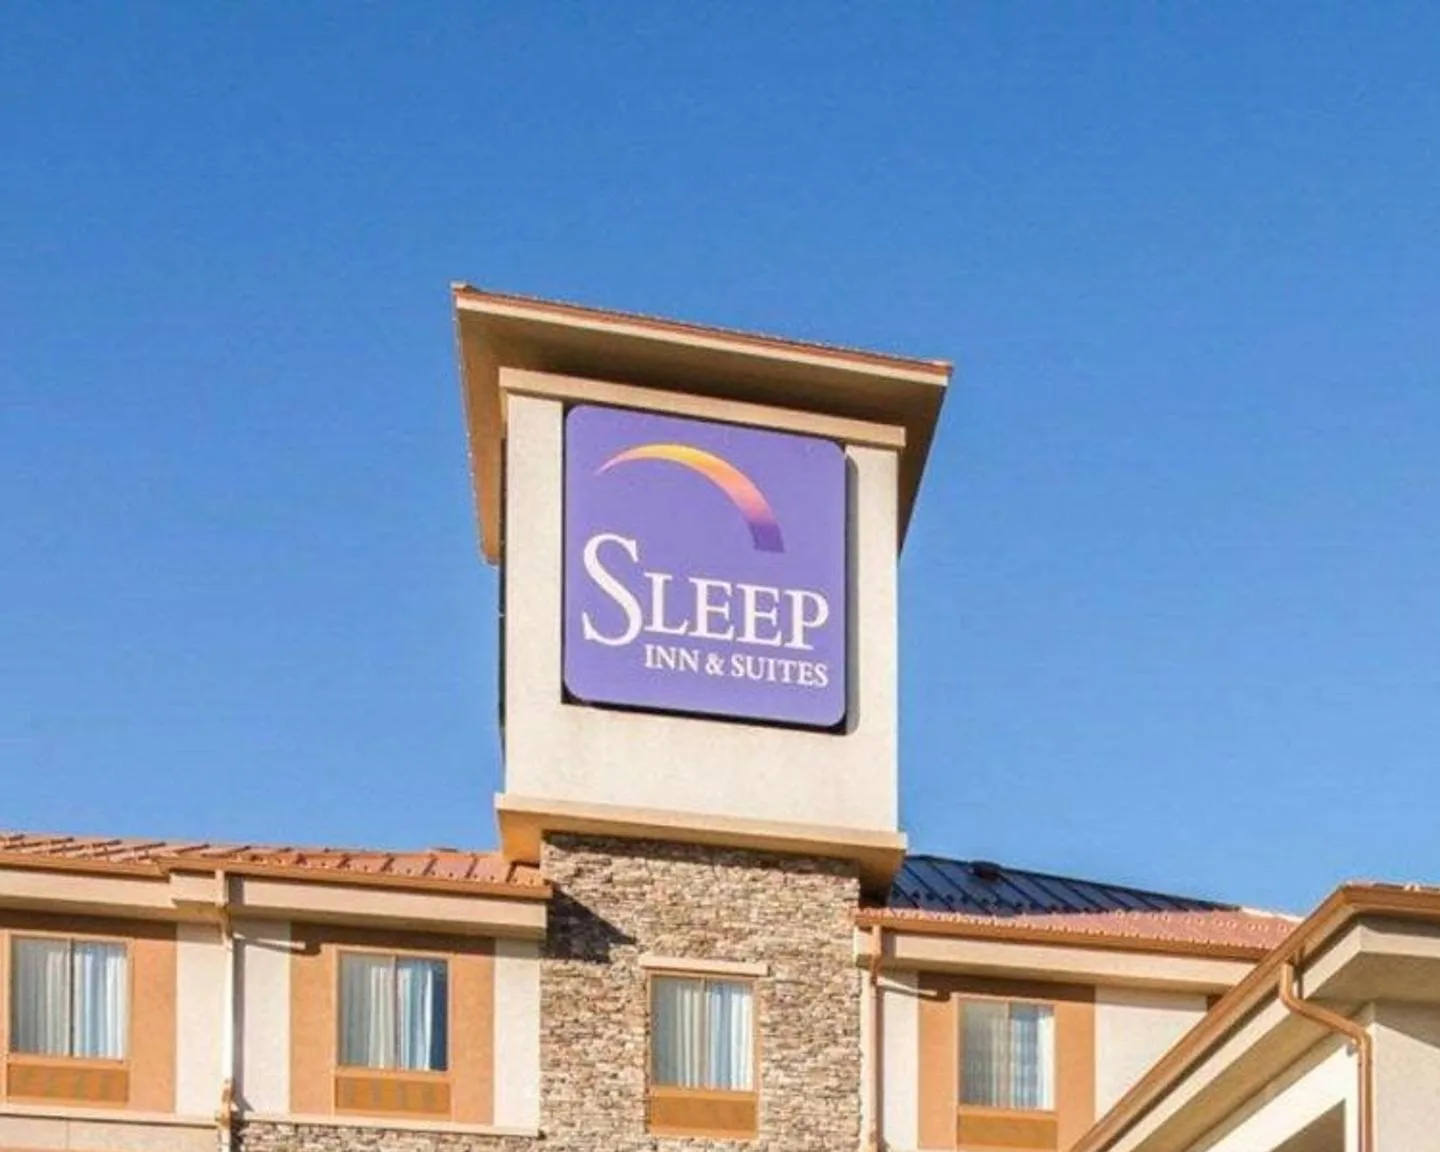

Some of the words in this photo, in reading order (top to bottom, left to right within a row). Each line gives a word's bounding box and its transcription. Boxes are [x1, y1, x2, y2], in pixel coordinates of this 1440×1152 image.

[582, 533, 829, 650] SLEEP
[644, 644, 699, 671] INN
[704, 653, 725, 676] &
[730, 654, 829, 687] SUITES
